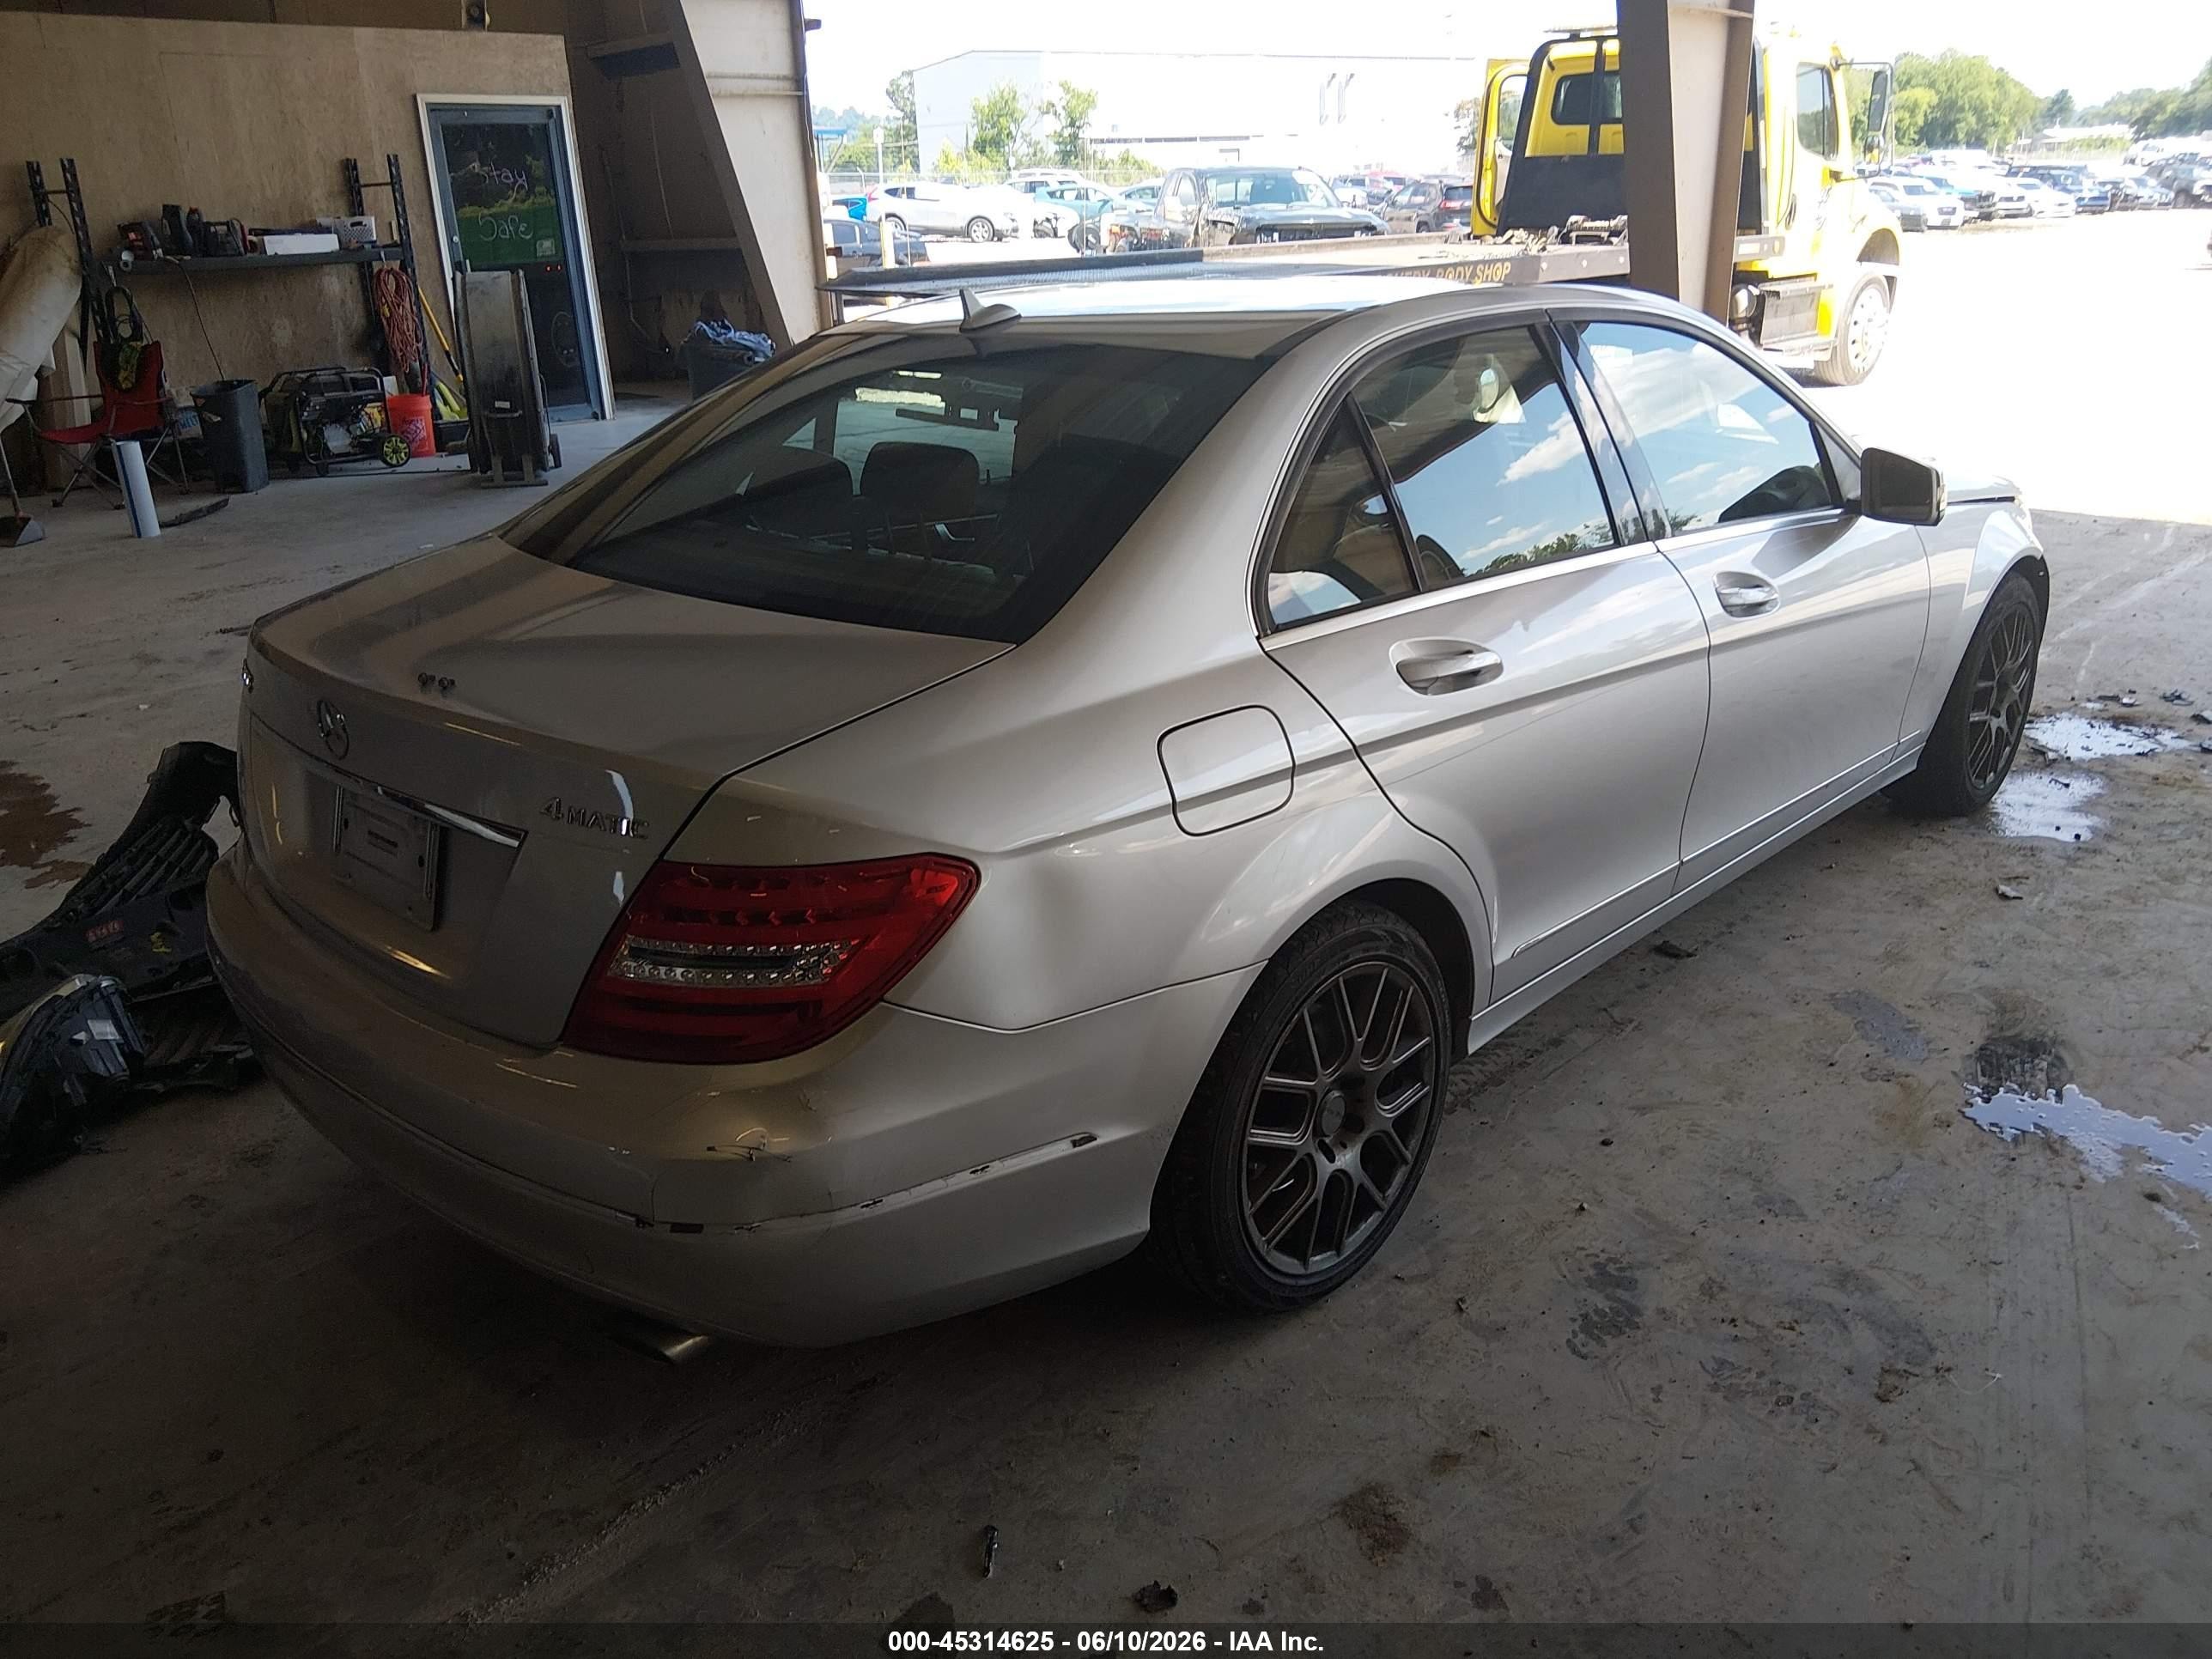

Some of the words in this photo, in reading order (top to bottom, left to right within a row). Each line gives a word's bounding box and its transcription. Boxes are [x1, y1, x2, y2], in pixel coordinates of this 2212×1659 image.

[478, 213, 533, 240] Safe
[1474, 261, 1511, 283] SHOP
[538, 795, 651, 840] 4MATIC
